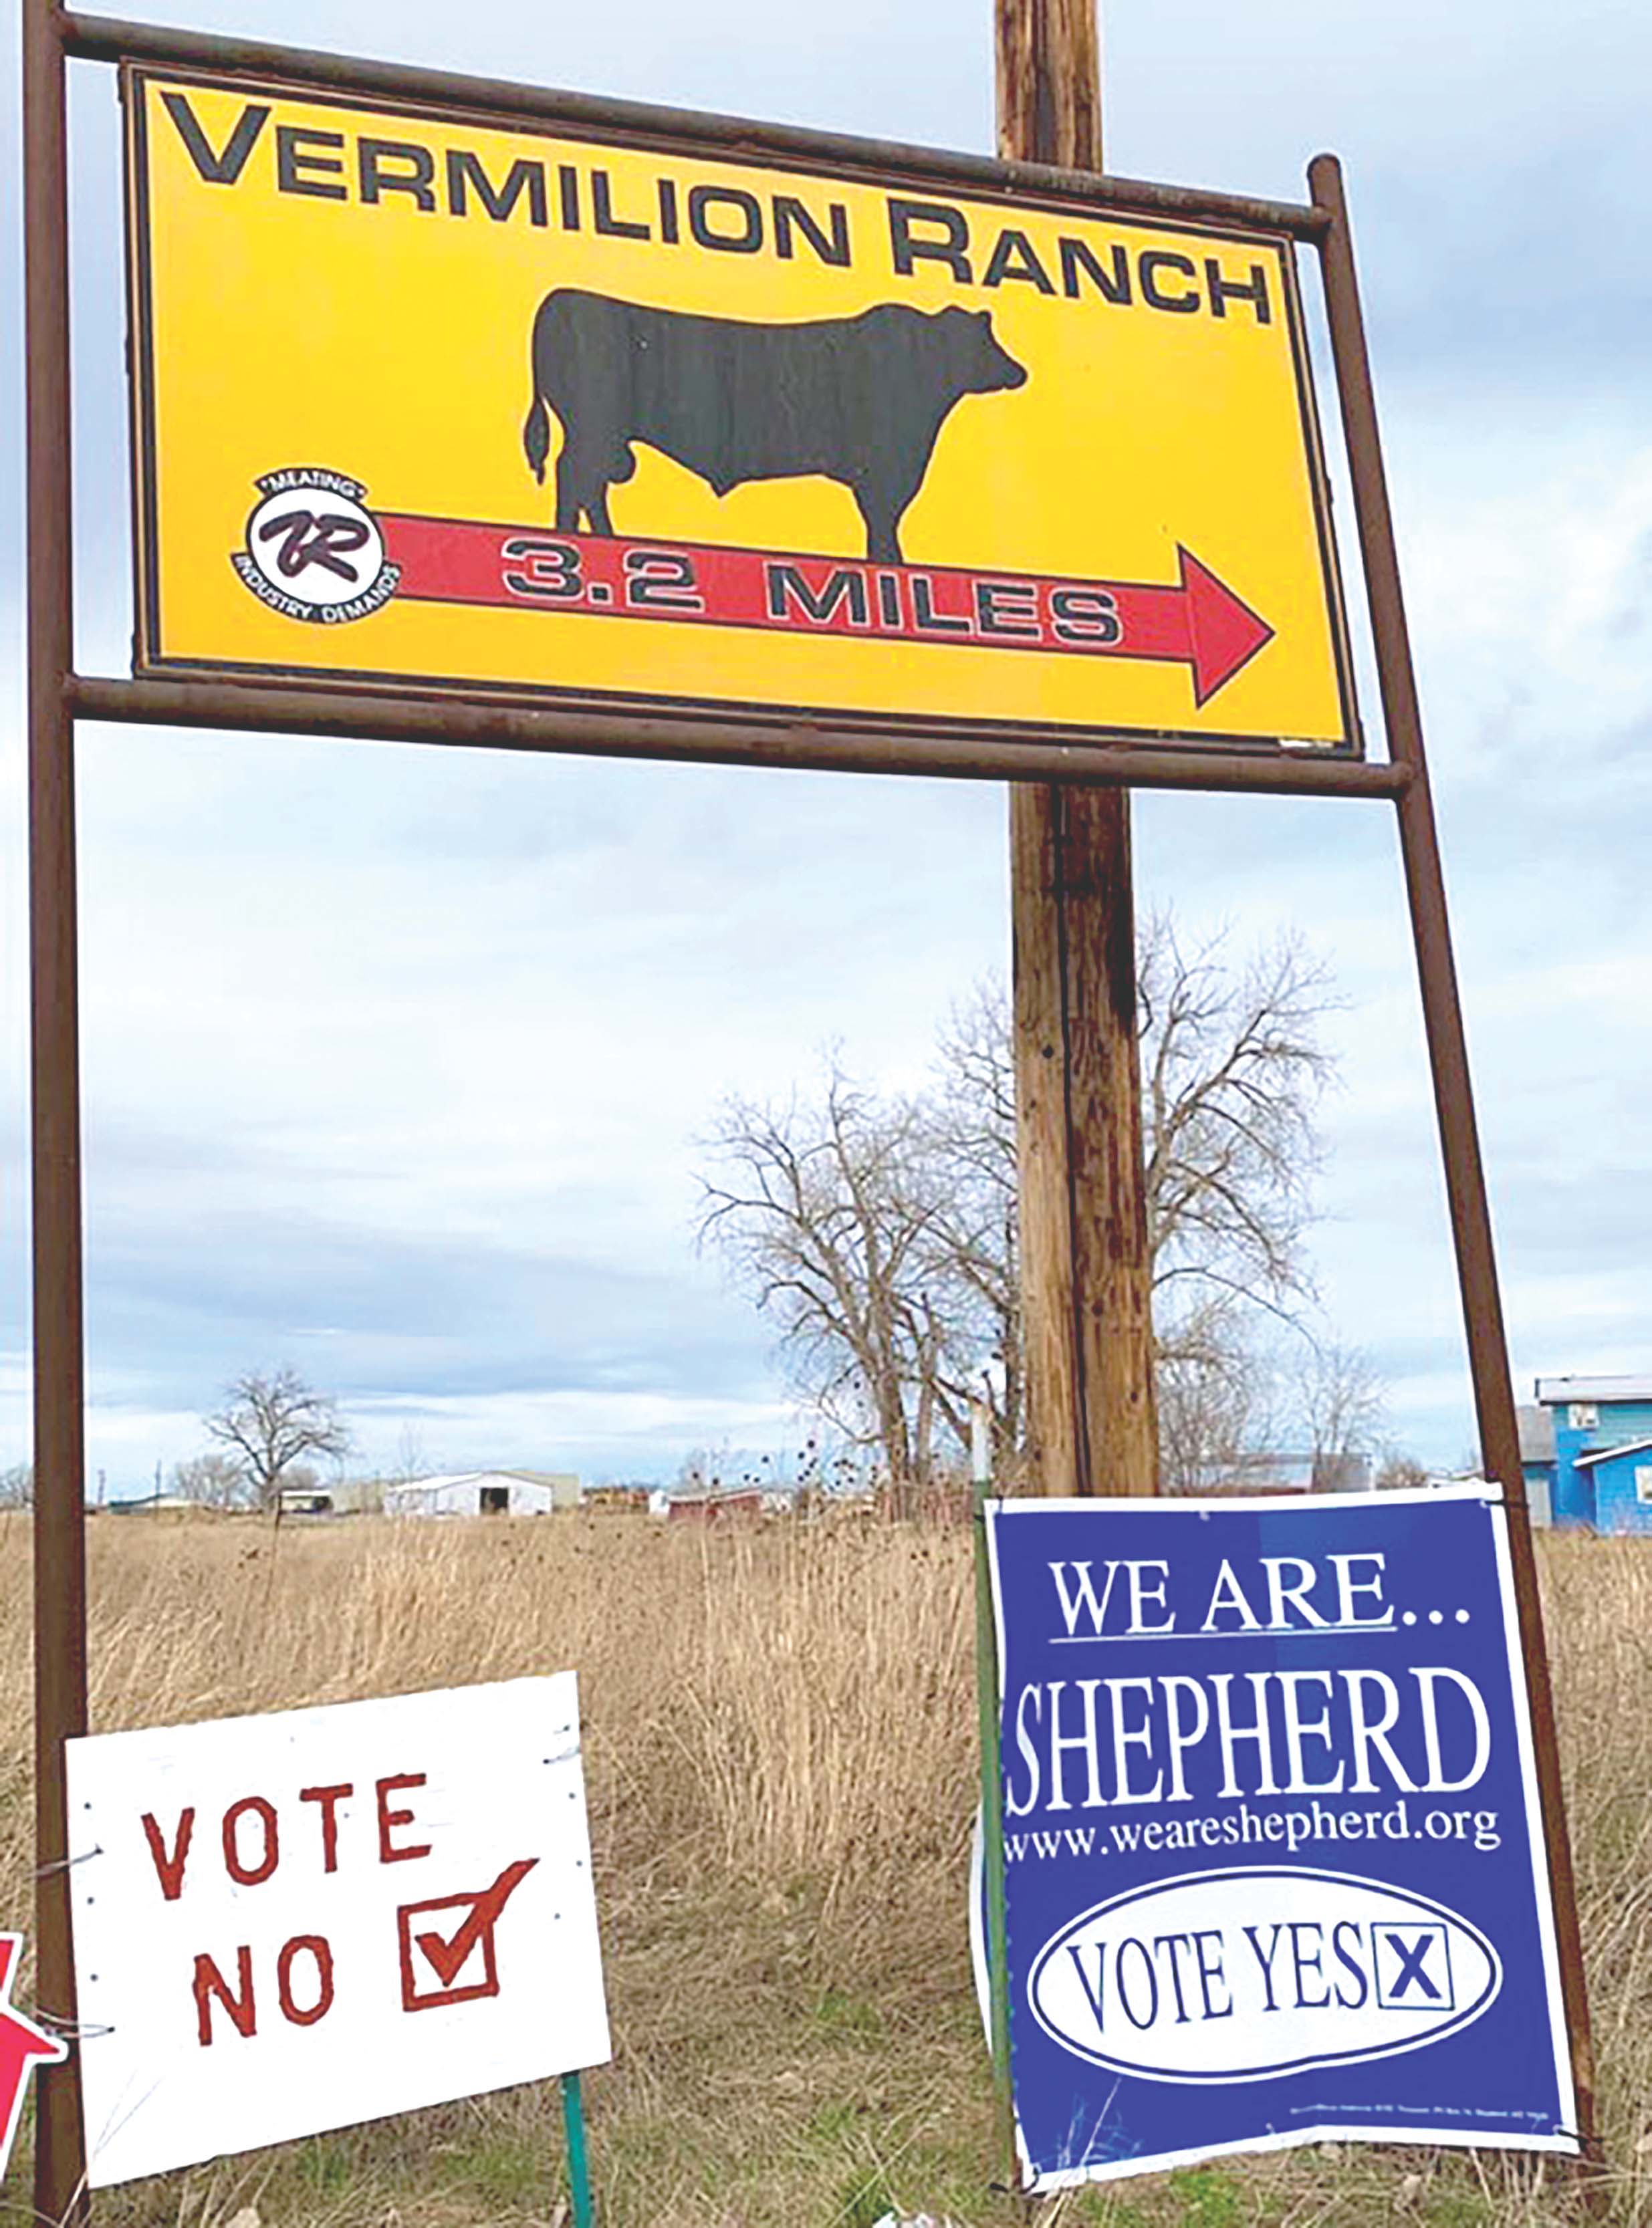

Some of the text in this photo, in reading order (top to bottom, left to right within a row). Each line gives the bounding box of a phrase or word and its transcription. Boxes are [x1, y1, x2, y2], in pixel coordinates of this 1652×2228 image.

[160, 92, 1270, 324] VERMILION RANCH
[235, 555, 400, 623] INDUSTRY DEMANDS
[501, 537, 1123, 648] 3.2 MILES
[1048, 1553, 1471, 1636] WE ARE...
[1004, 1666, 1491, 1817] SHEPHERD
[141, 1773, 432, 1900] VOTE
[1004, 1800, 1502, 1862] www.weareshepherd.org
[193, 1935, 334, 2046] NO
[1066, 1930, 1233, 2034] VOTE
[1242, 1921, 1369, 2011] YES
